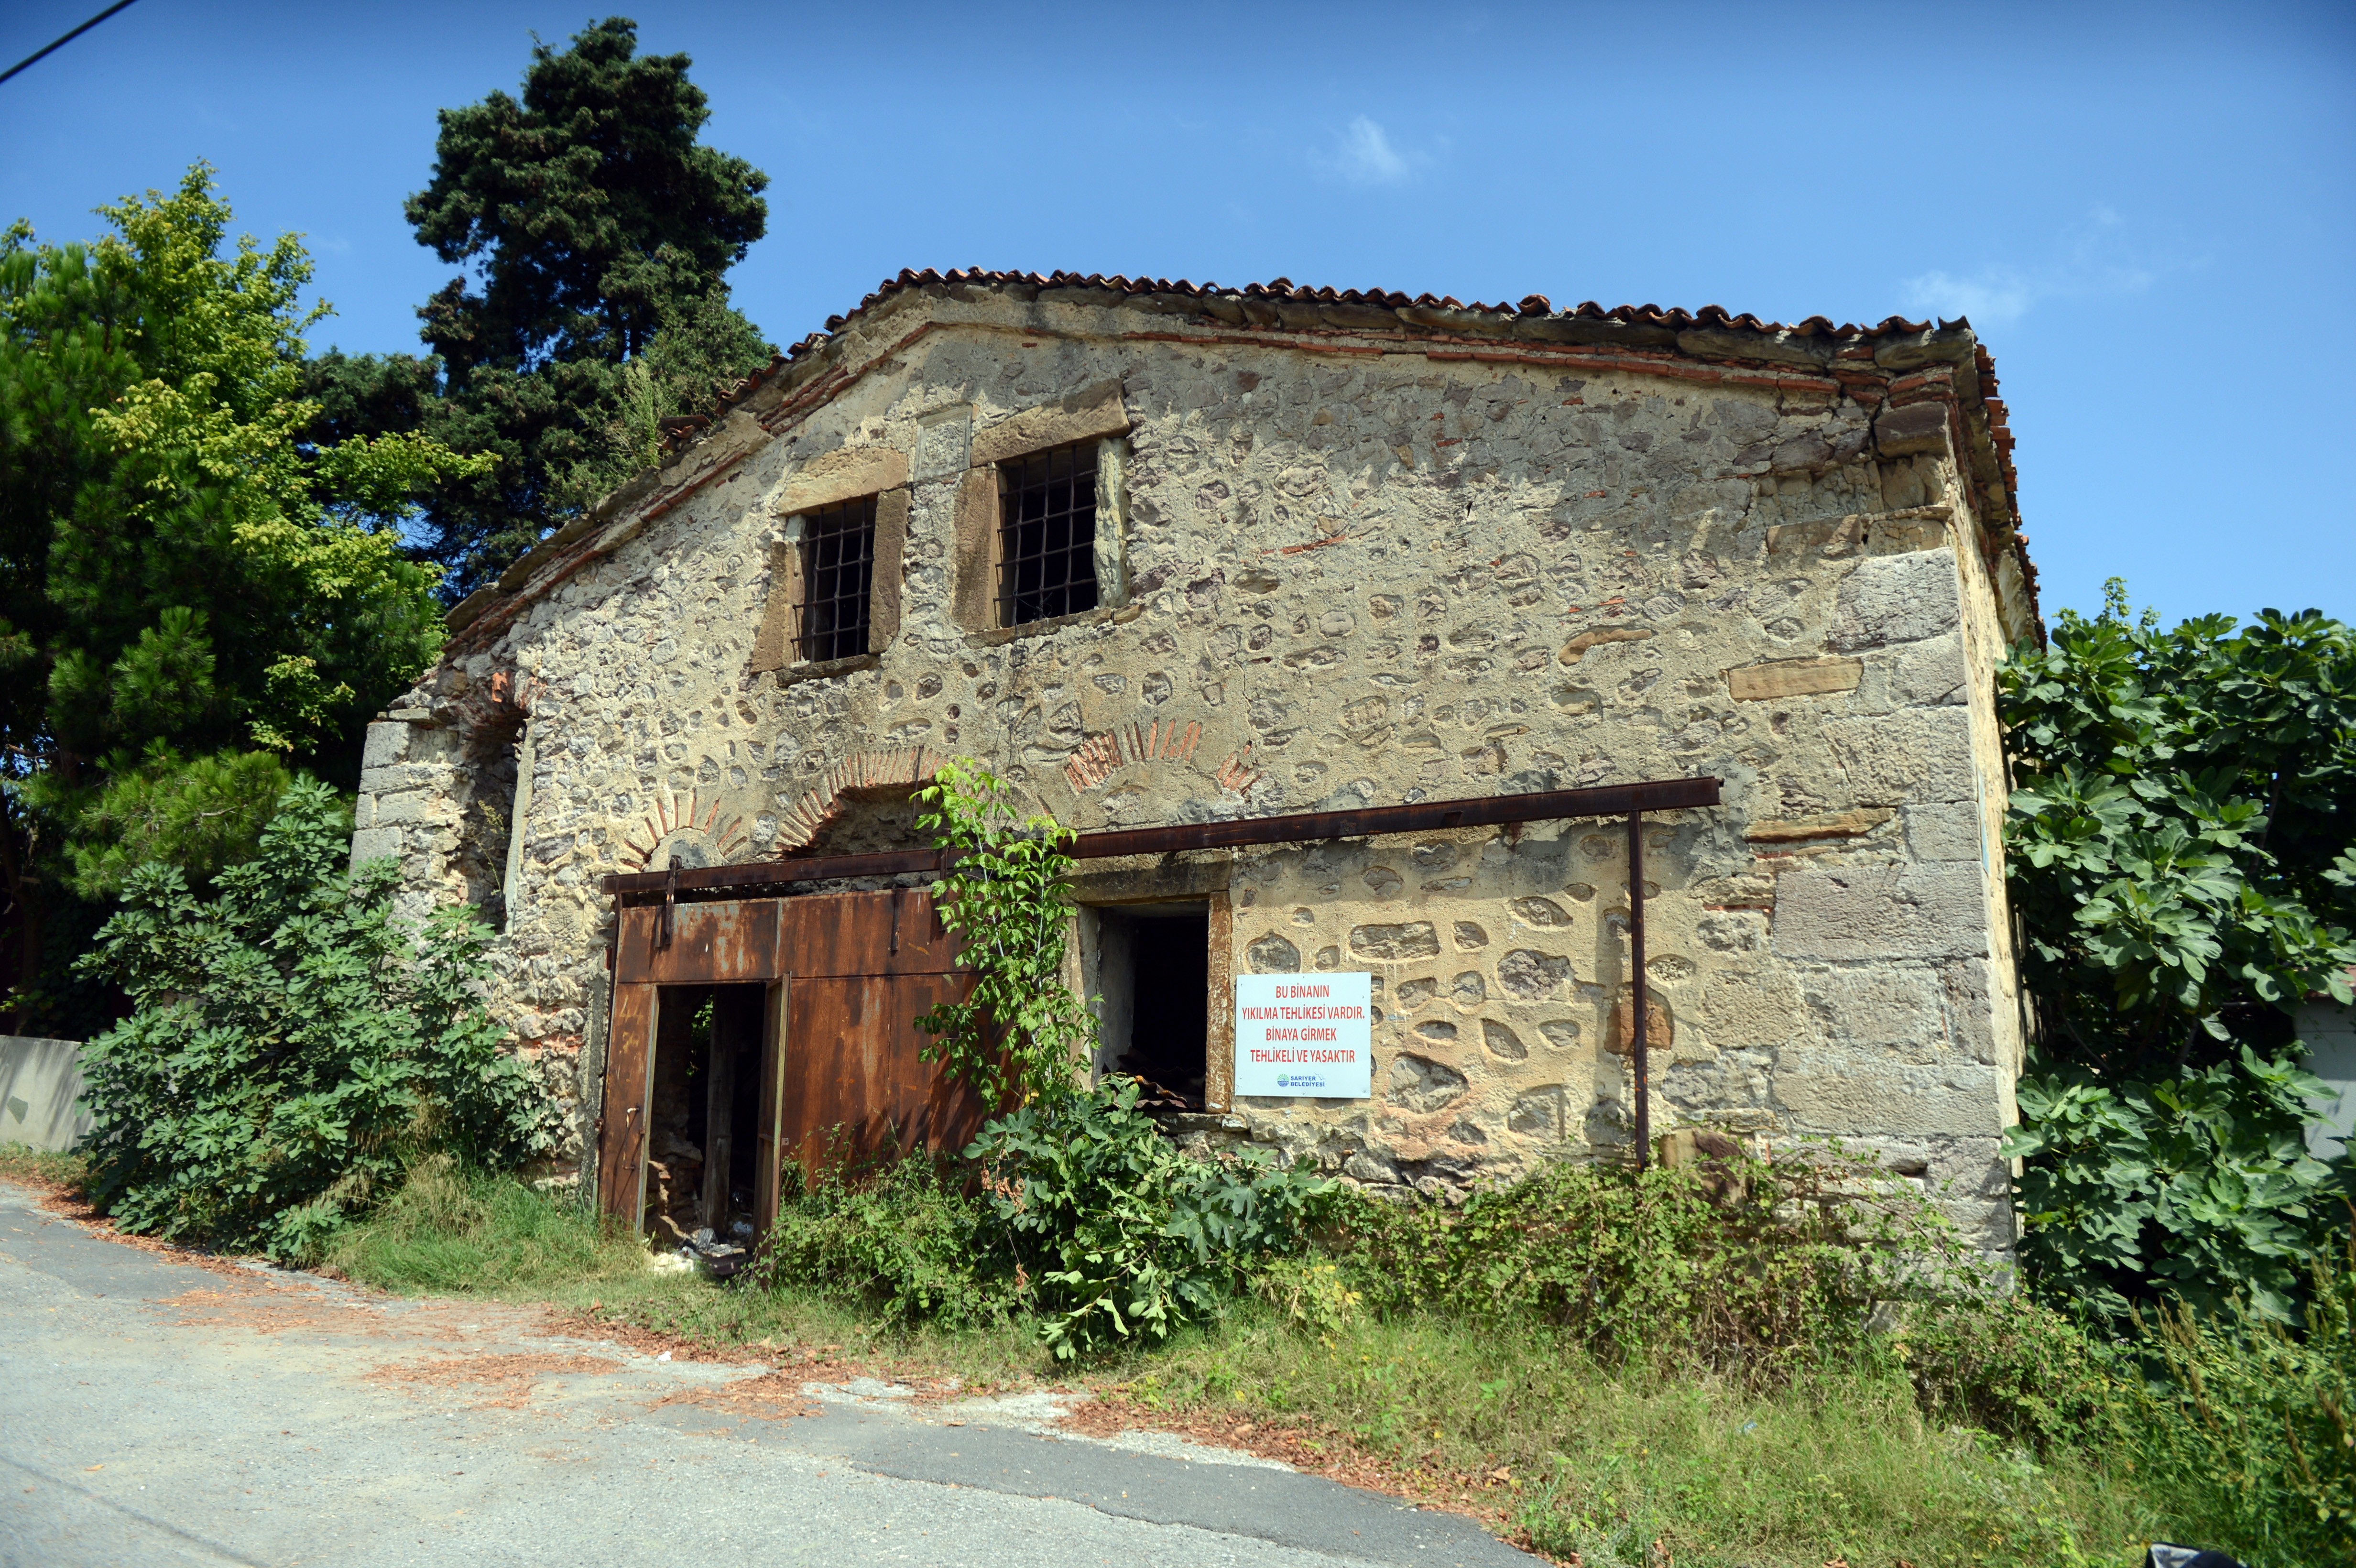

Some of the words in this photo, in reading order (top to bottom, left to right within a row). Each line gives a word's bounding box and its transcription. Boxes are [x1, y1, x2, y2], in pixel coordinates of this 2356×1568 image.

[1276, 986, 1288, 998] BU
[1291, 983, 1329, 998] BİNANIN
[1242, 1007, 1278, 1019] YIKILMA
[1280, 1004, 1325, 1019] TEHLİKESİ
[1328, 1006, 1364, 1019] VARDIR.
[1266, 1025, 1298, 1041] BİNAYA
[1301, 1025, 1337, 1041] GİRMEK
[1251, 1047, 1294, 1062] TEHLİKELİ
[1297, 1050, 1308, 1062] VE
[1310, 1050, 1355, 1062] YASAKTIR
